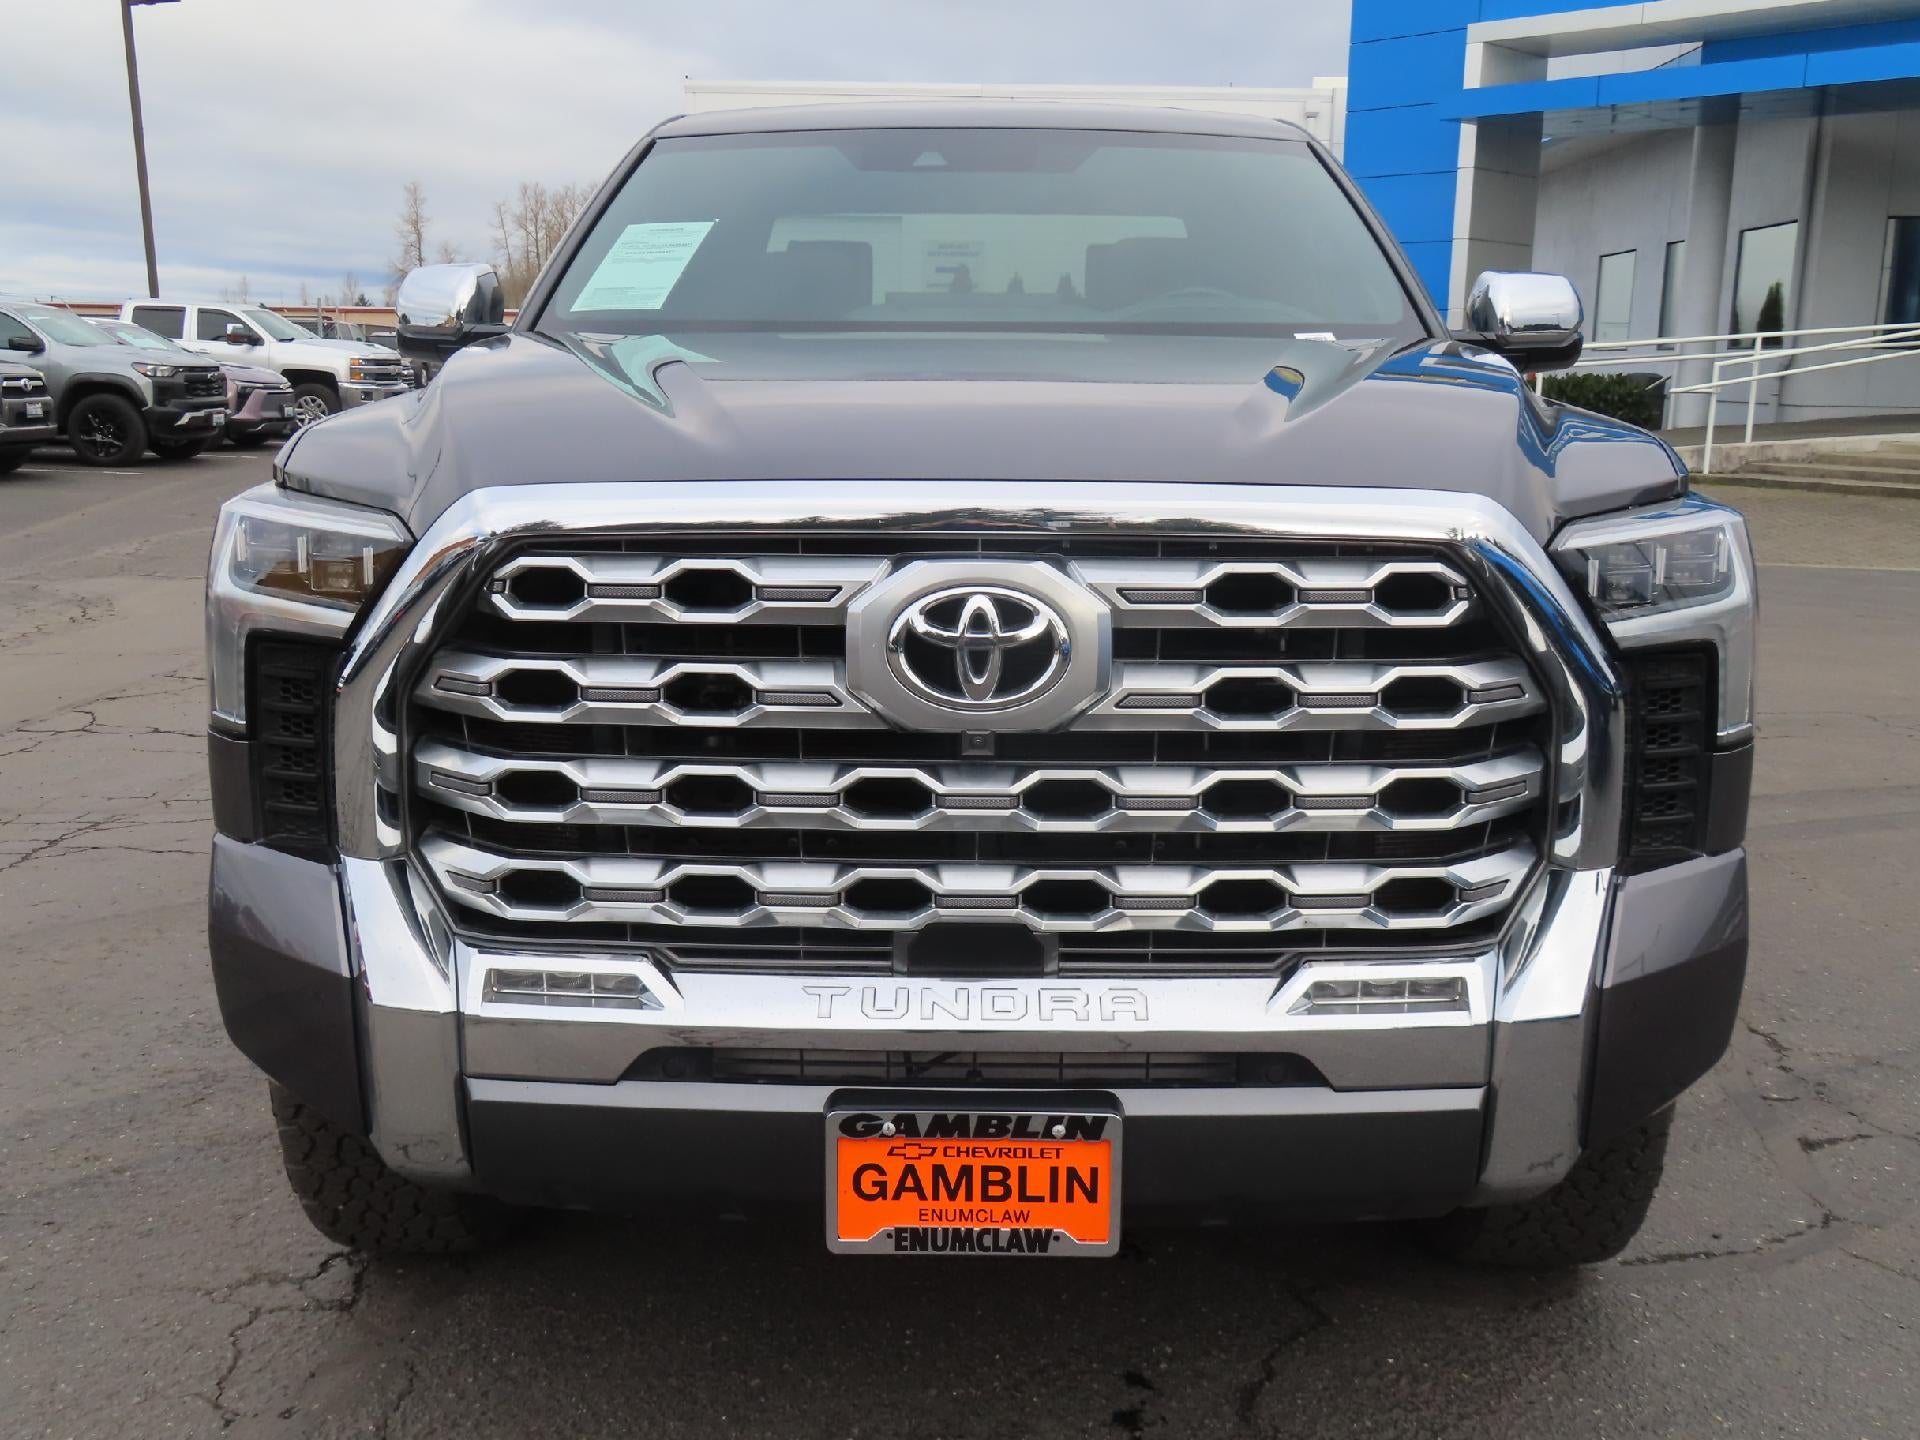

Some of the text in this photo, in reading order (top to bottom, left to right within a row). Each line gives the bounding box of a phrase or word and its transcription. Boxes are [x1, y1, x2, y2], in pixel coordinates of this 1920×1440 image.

[802, 986, 1149, 1021] TUNDRA
[838, 1113, 1109, 1141] GAMBLIN
[942, 1146, 1064, 1160] CHEVROLET
[852, 1163, 1099, 1204] GAMBLIN
[918, 1208, 1031, 1224] ENUMCLAW
[893, 1228, 1054, 1253] ENUMCLAW
